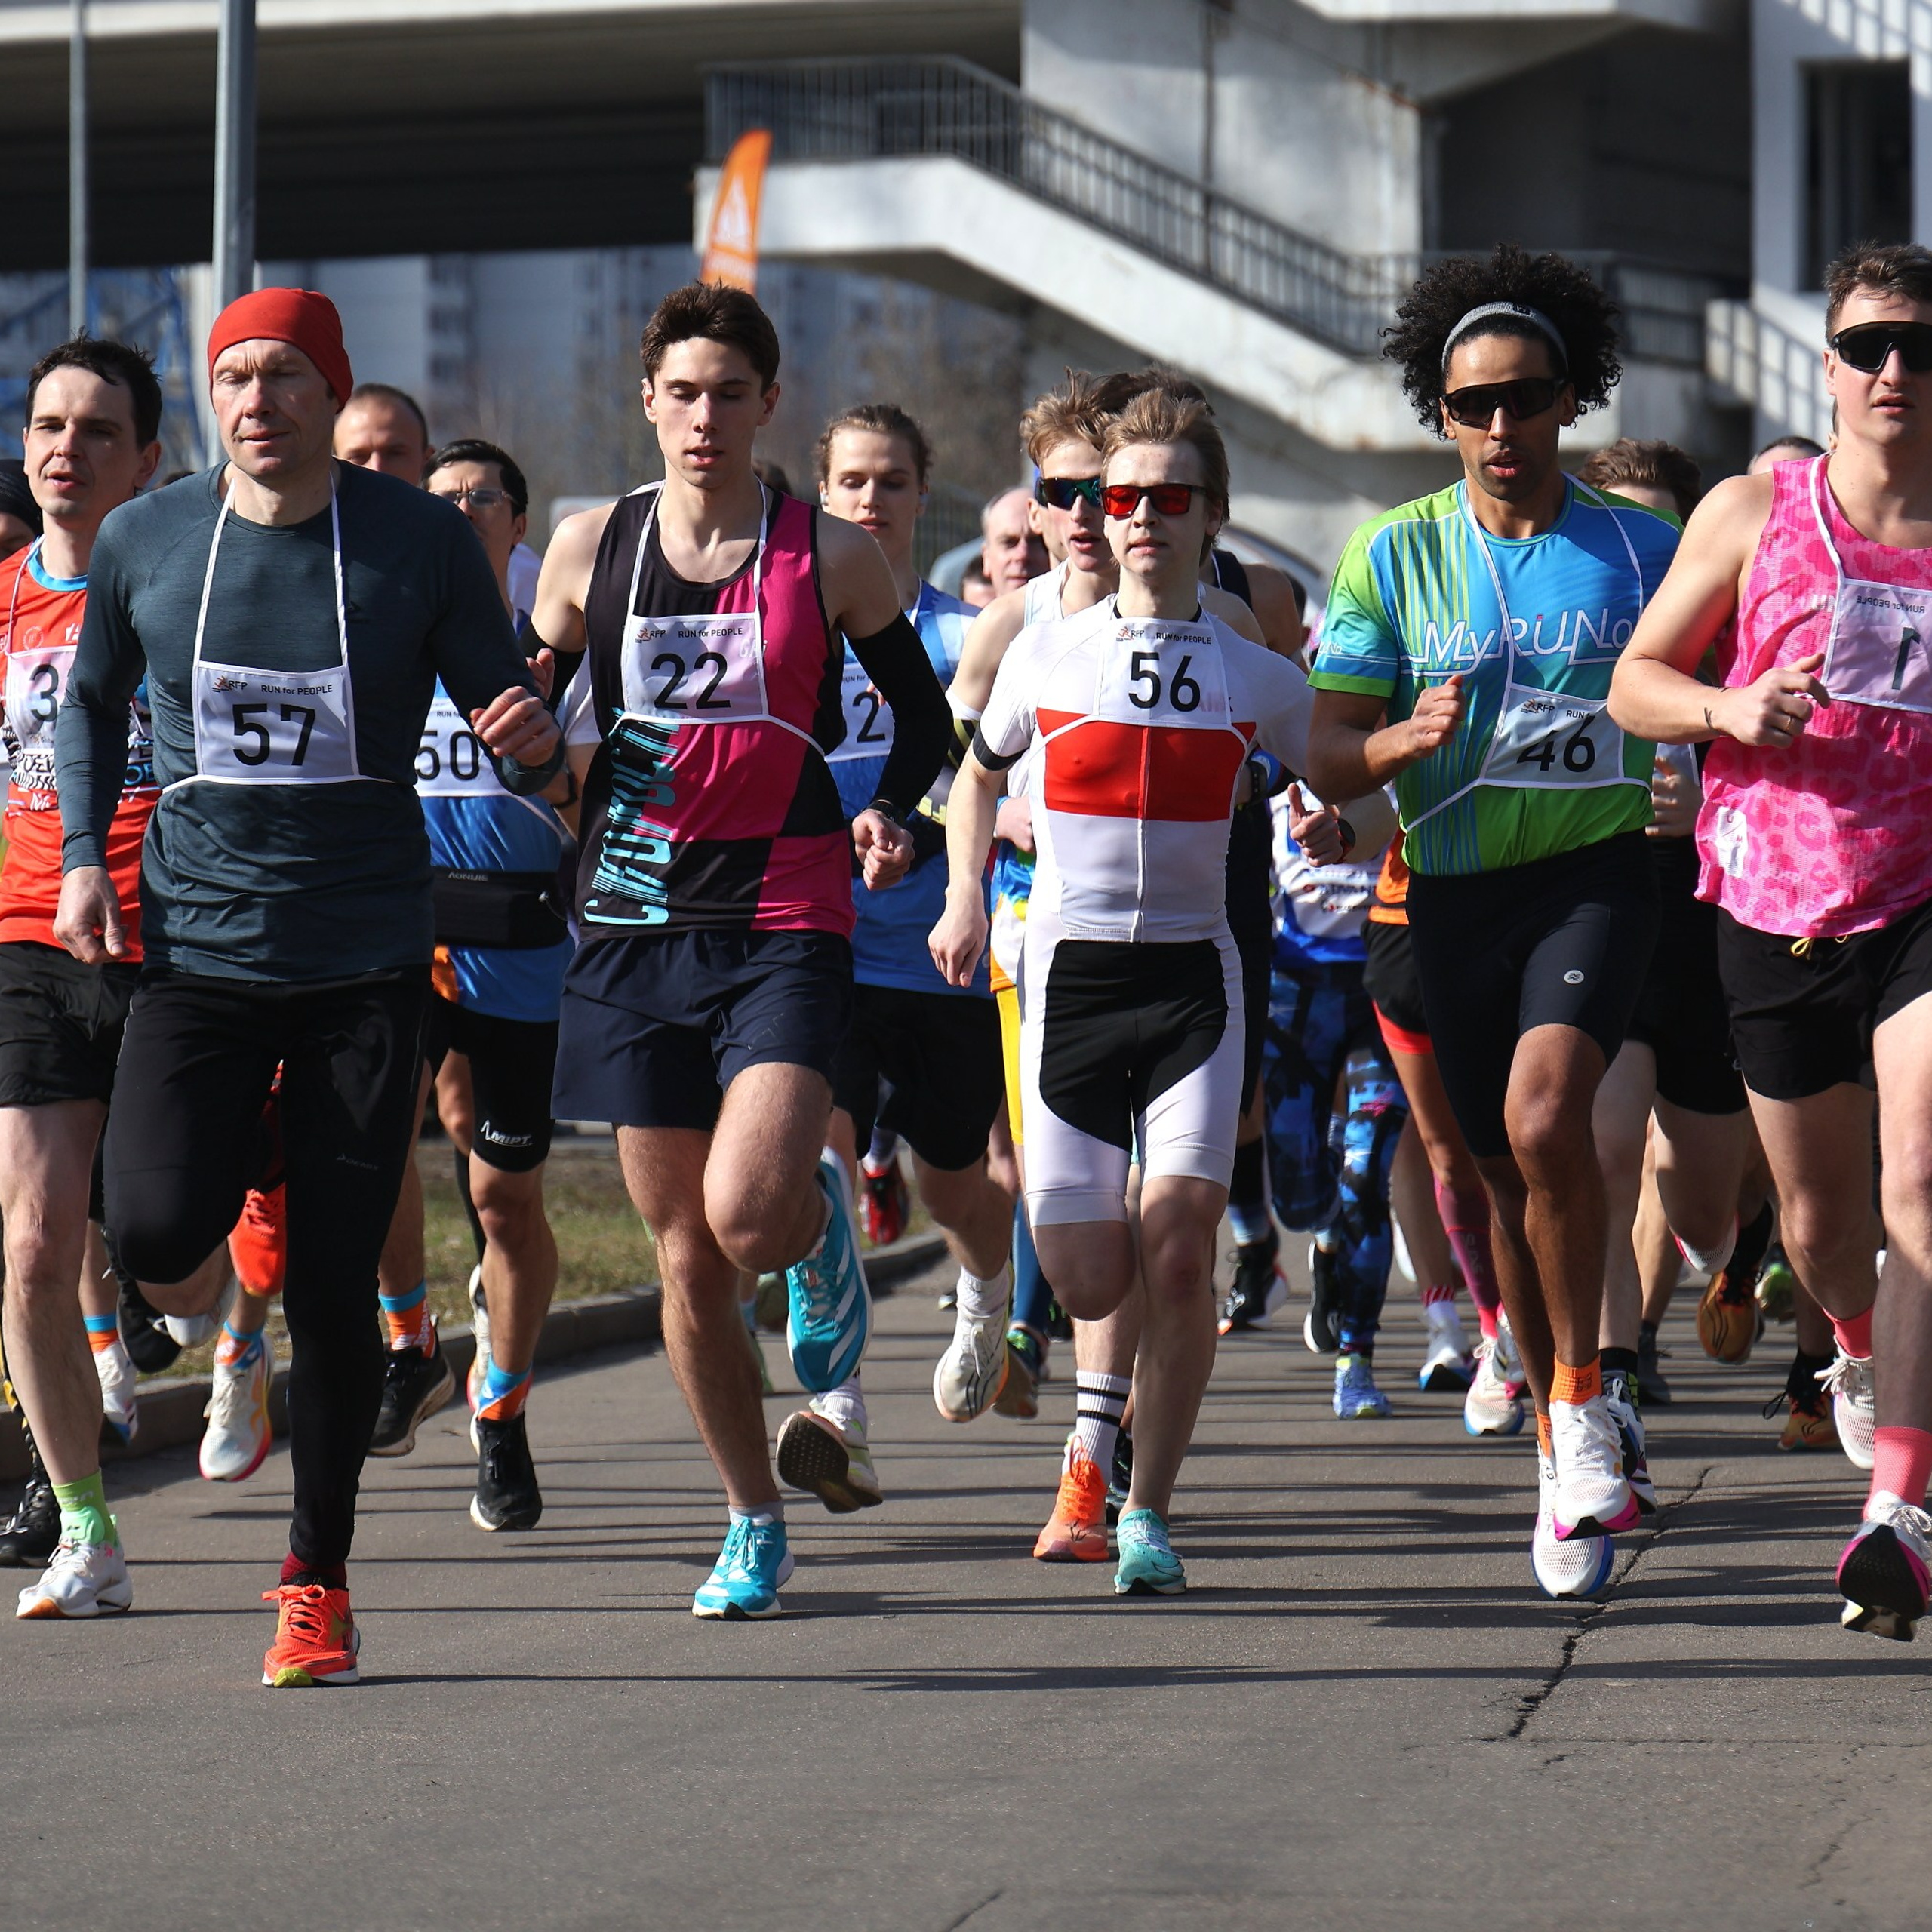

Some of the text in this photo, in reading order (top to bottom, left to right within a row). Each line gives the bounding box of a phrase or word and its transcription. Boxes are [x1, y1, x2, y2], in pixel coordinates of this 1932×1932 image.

[650, 629, 666, 638] RFP
[678, 628, 743, 638] RUN for PEOPLE
[1131, 629, 1145, 638] RFP
[1156, 632, 1173, 641] RUN
[1183, 635, 1211, 645] PEOPLE
[229, 680, 248, 690] RFP
[651, 651, 731, 709] 22
[1128, 651, 1201, 712] 56
[261, 685, 333, 696] RUN for PEOPLE
[1537, 703, 1555, 713] RFP
[1567, 709, 1585, 718] RUN
[232, 703, 316, 766] 57
[1517, 715, 1596, 772] 46
[415, 730, 480, 780] 50
[491, 1130, 531, 1145] MIPT
